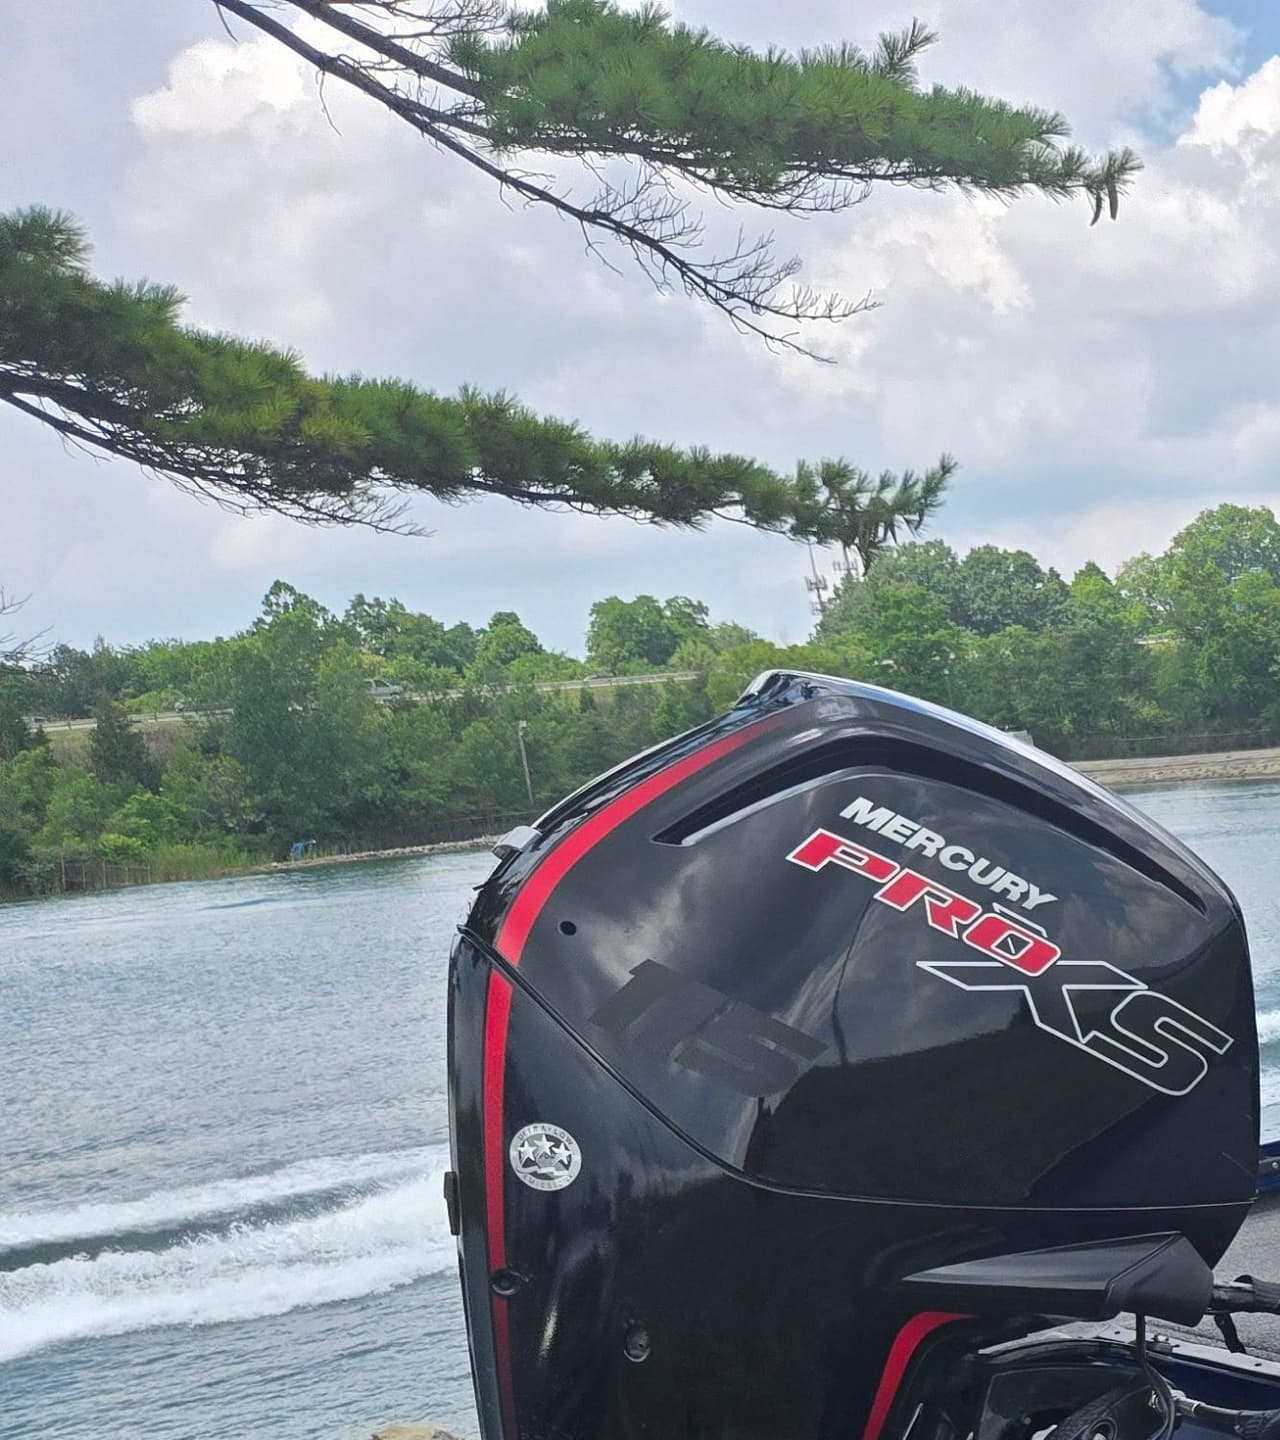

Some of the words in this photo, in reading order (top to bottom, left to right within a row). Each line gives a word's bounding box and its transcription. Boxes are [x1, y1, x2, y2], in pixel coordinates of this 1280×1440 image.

[786, 828, 1061, 976] PRO
[840, 797, 1058, 910] MERCURY
[916, 903, 1234, 1096] XS
